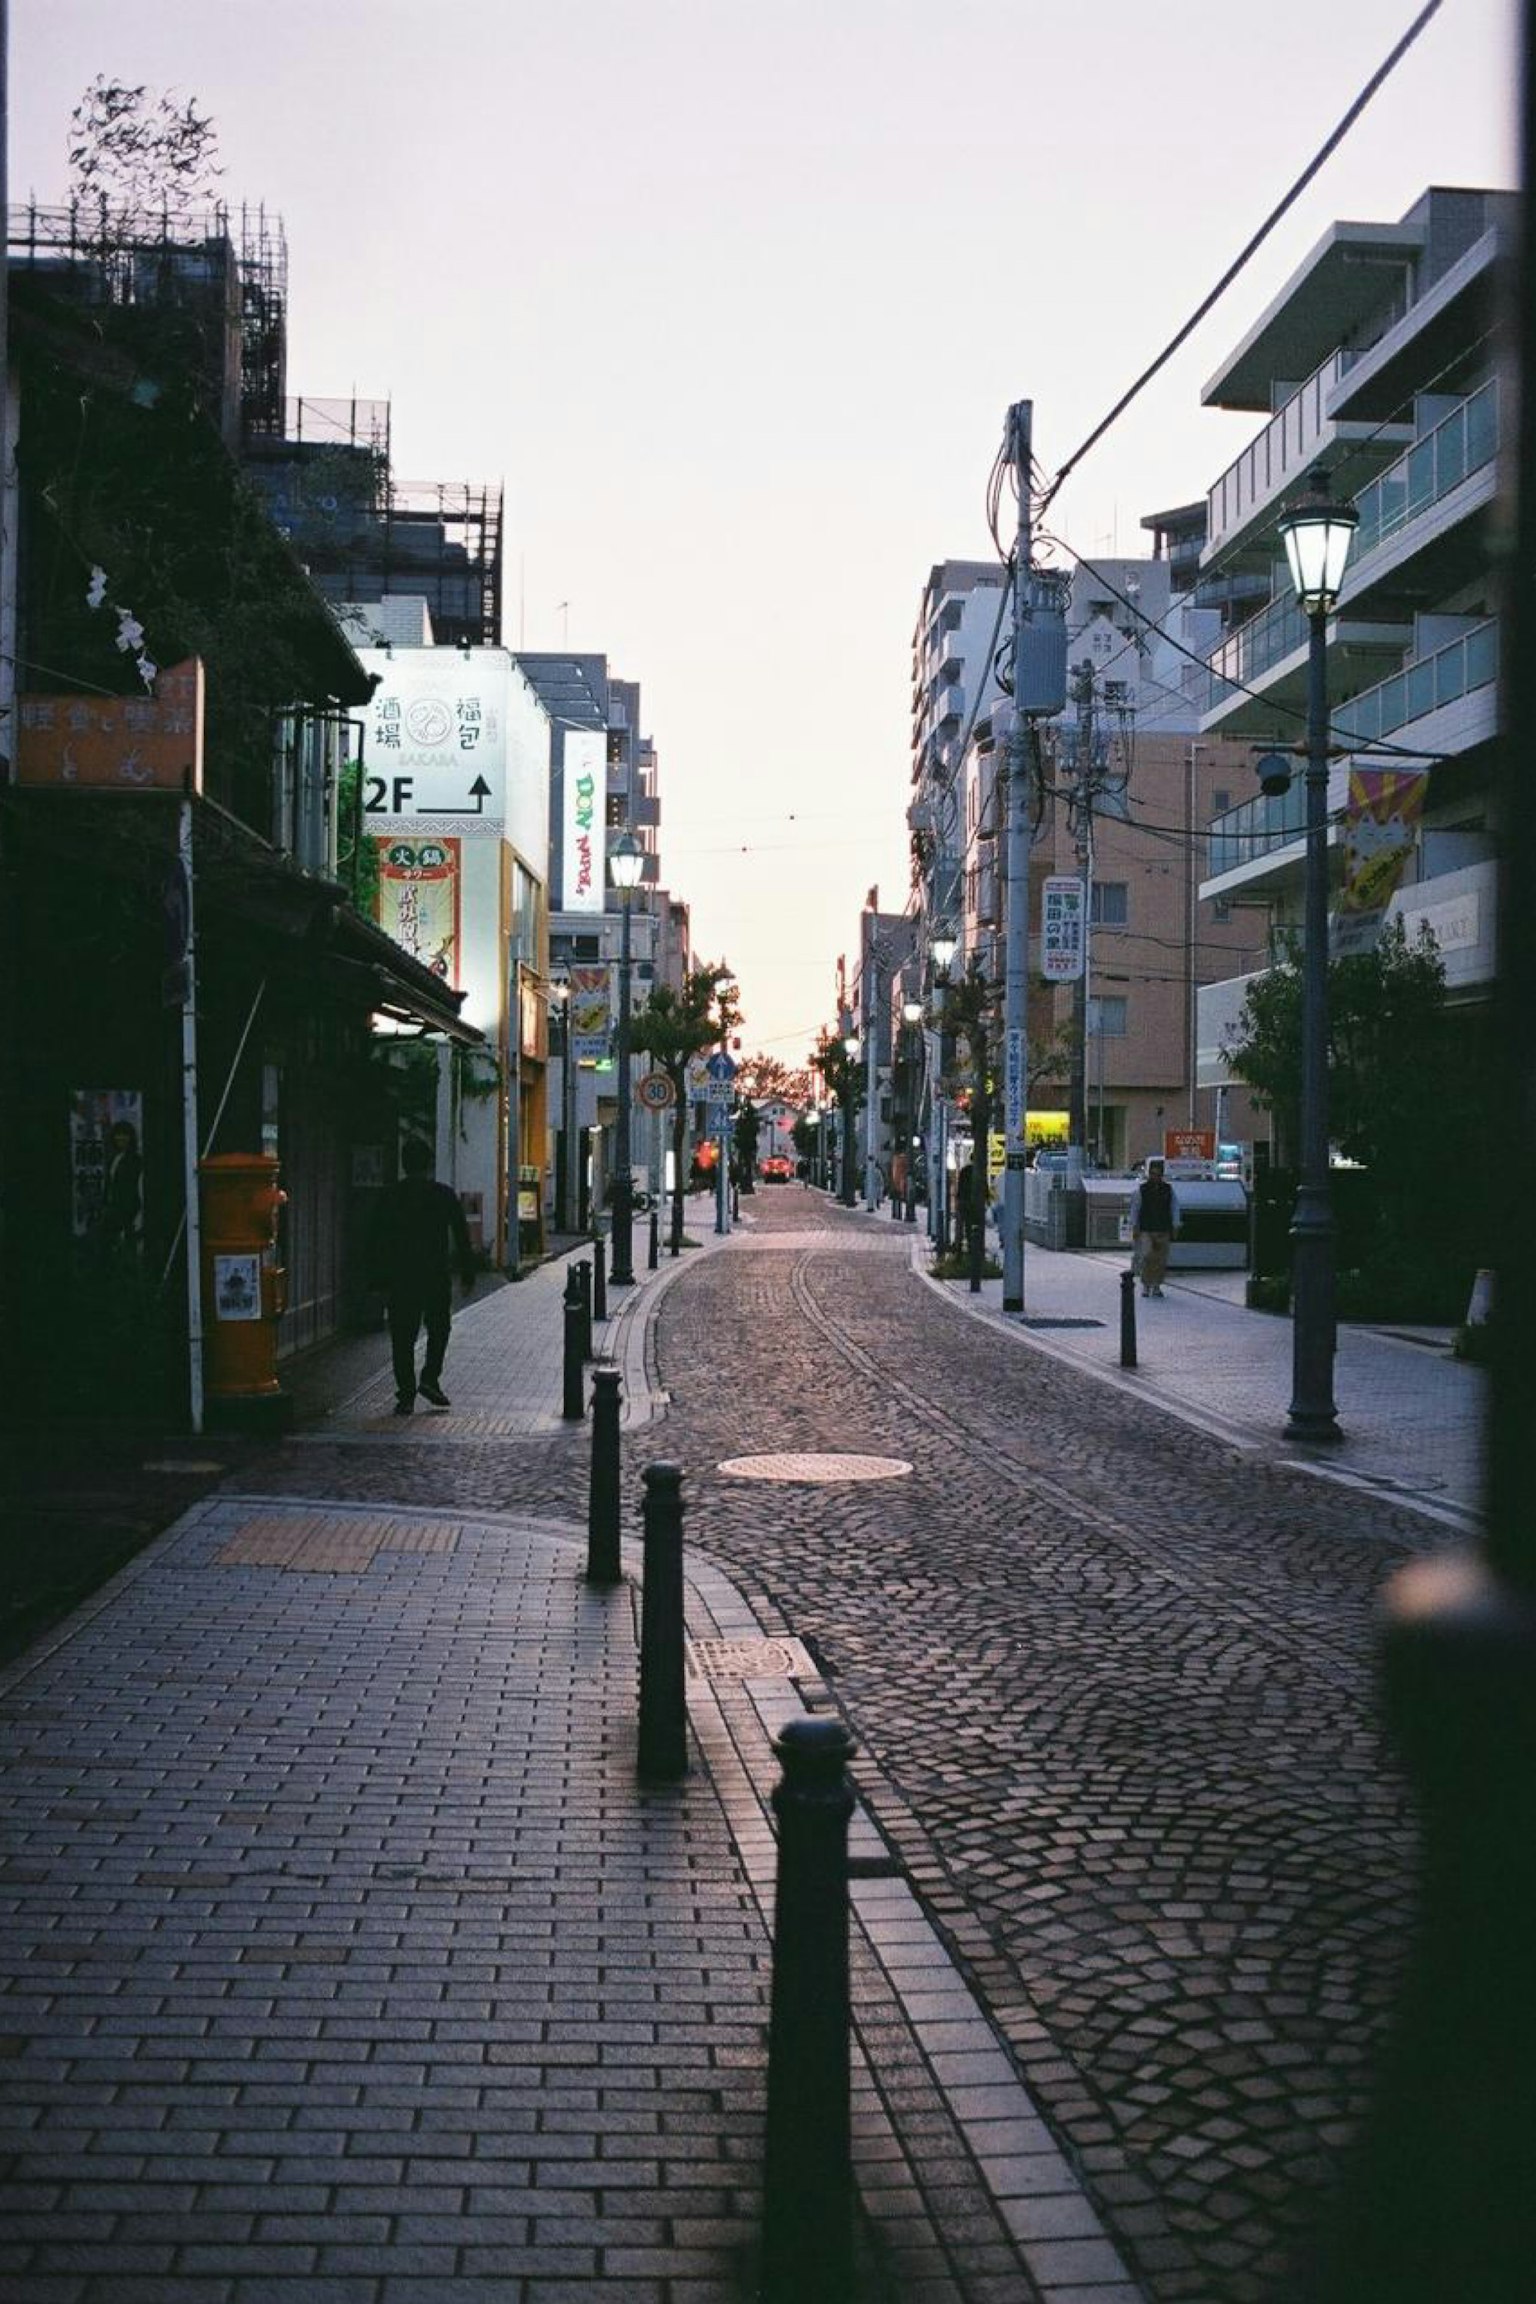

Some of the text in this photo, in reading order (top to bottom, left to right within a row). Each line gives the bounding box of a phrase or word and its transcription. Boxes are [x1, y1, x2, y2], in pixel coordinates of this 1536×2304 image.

[375, 696, 401, 749] 酒場
[456, 696, 482, 750] 福包
[364, 777, 414, 813] 2F
